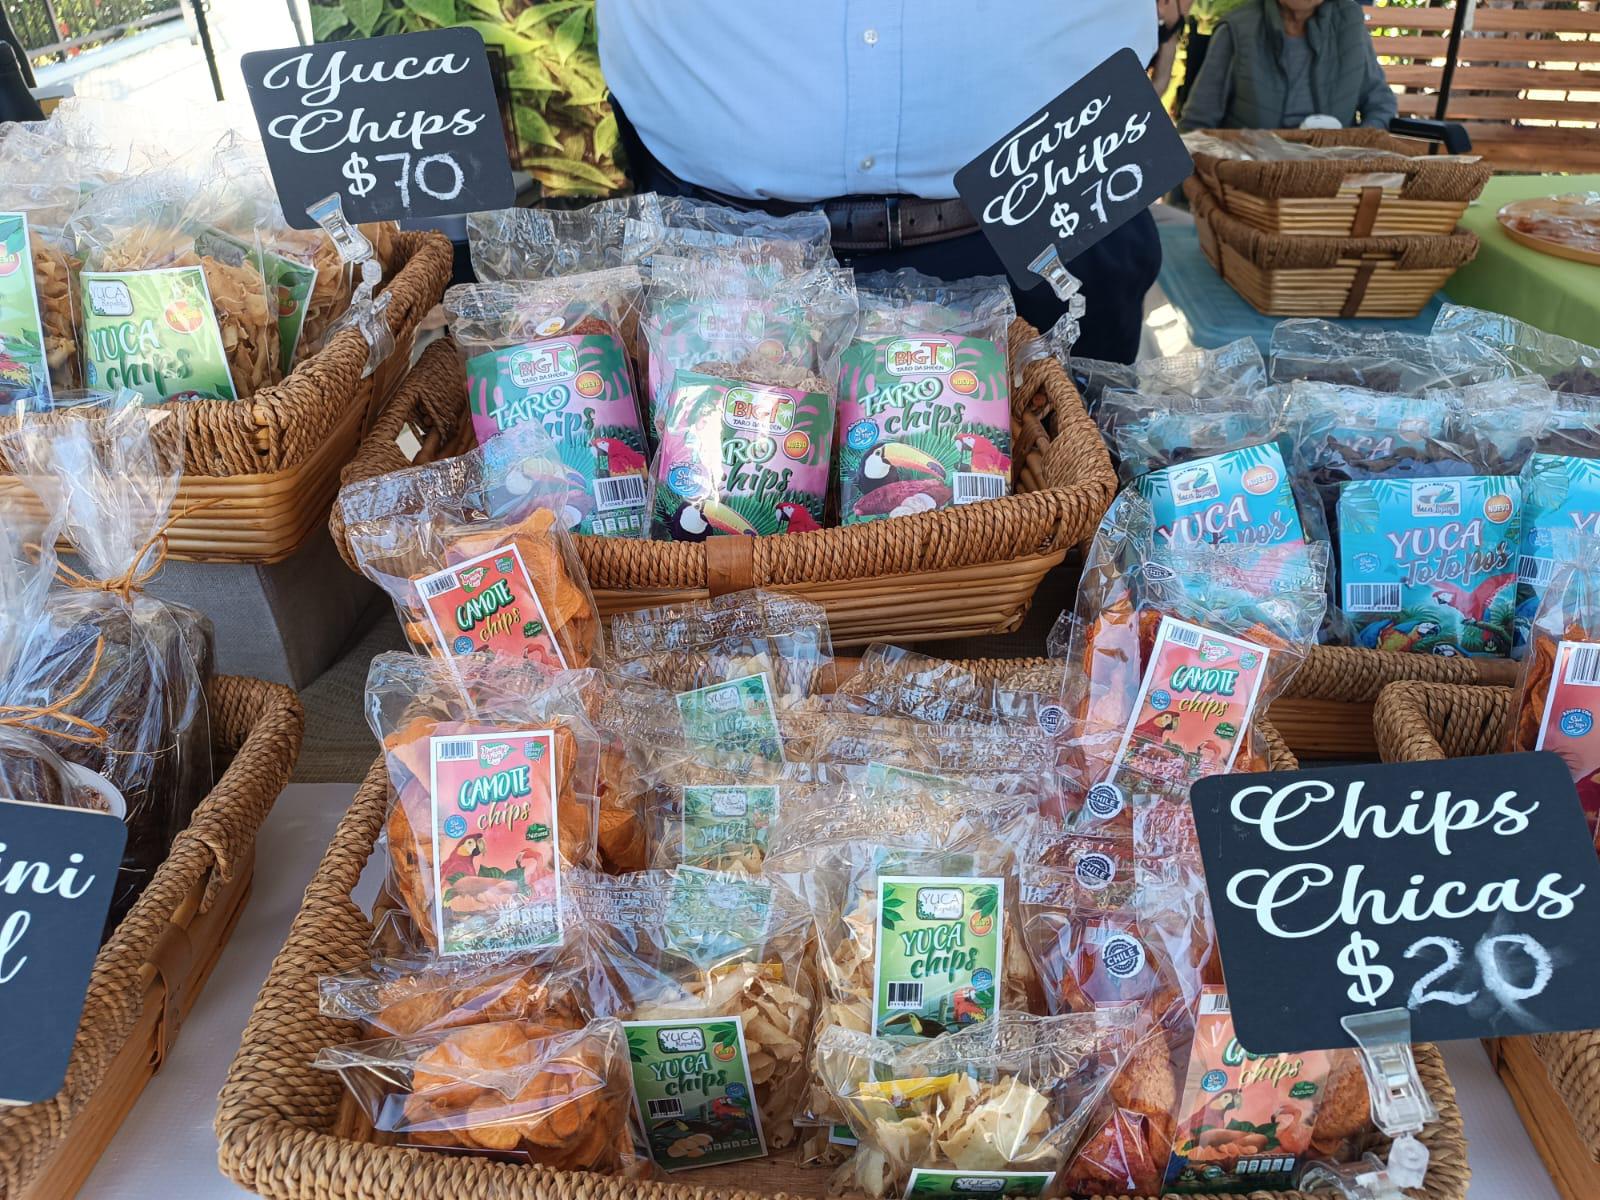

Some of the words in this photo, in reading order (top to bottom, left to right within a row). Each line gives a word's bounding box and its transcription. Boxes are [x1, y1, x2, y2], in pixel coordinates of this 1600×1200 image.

[262, 50, 471, 107] Yuca
[267, 109, 486, 155] Chips
[989, 94, 1112, 178] Taro
[342, 152, 466, 208] $70
[982, 111, 1151, 226] Chips
[90, 319, 161, 363] YUCA
[489, 384, 571, 432] TARO
[858, 375, 944, 417] TARO
[884, 398, 967, 436] chips
[1158, 494, 1249, 546] YUCA
[1386, 518, 1484, 560] YUCA
[1396, 540, 1515, 588] Totopos
[457, 579, 515, 630] CAMOTE
[480, 608, 521, 642] chips
[1170, 665, 1240, 696] CAMOTE
[1179, 690, 1230, 722] chips
[459, 766, 532, 811] CAMOTE
[1090, 793, 1116, 808] CHILE
[477, 800, 532, 832] chips
[1230, 780, 1540, 856] Chips
[1081, 861, 1107, 880] CHILE
[922, 893, 960, 905] YUCA
[1226, 863, 1586, 939] Chicas
[901, 922, 965, 957] YUCA
[1106, 947, 1136, 966] CHILE
[910, 947, 979, 984] chips
[1336, 931, 1555, 1011] $20
[662, 1031, 700, 1042] YUCA
[649, 1052, 711, 1082] YUCA
[665, 1069, 728, 1097] chips
